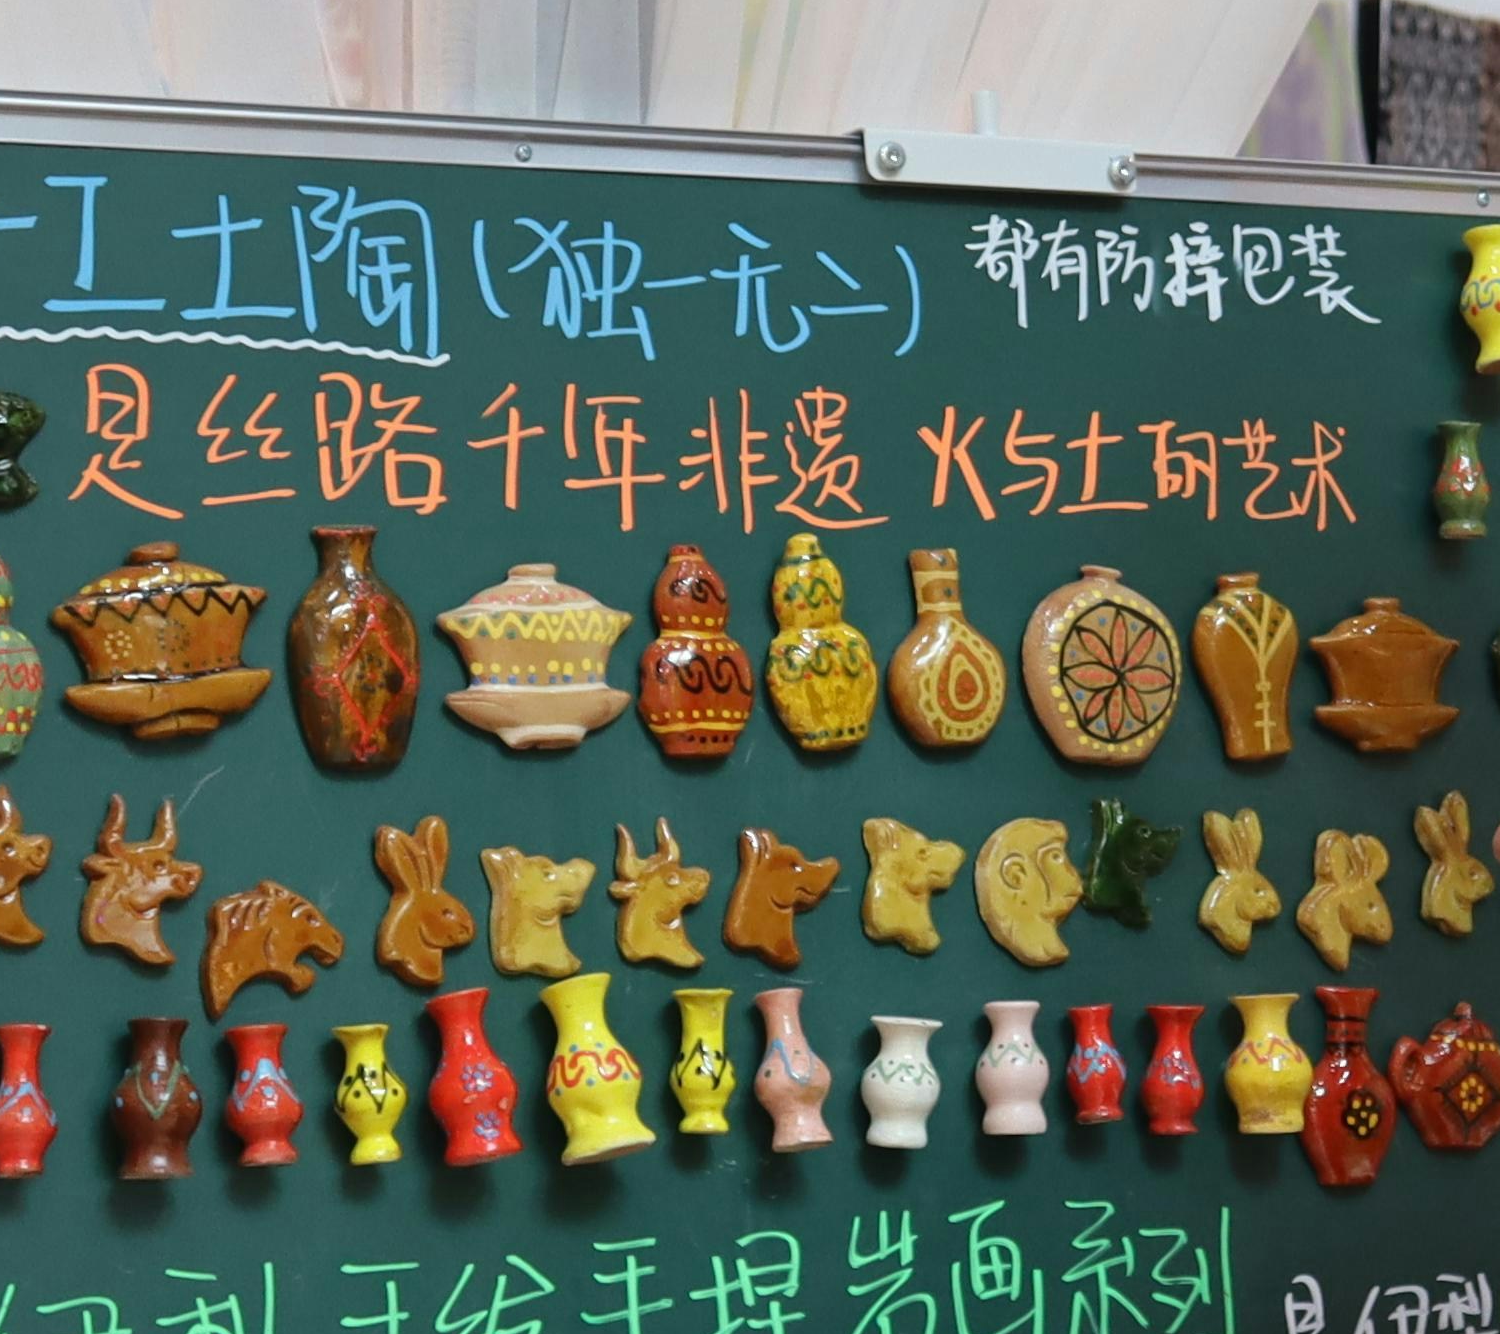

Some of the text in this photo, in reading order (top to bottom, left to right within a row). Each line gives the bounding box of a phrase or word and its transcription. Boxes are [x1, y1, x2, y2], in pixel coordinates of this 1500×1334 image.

[966, 217, 1381, 327] 都有防摔包装
[63, 364, 1357, 533] 是丝路千年非遗 火与土的艺术
